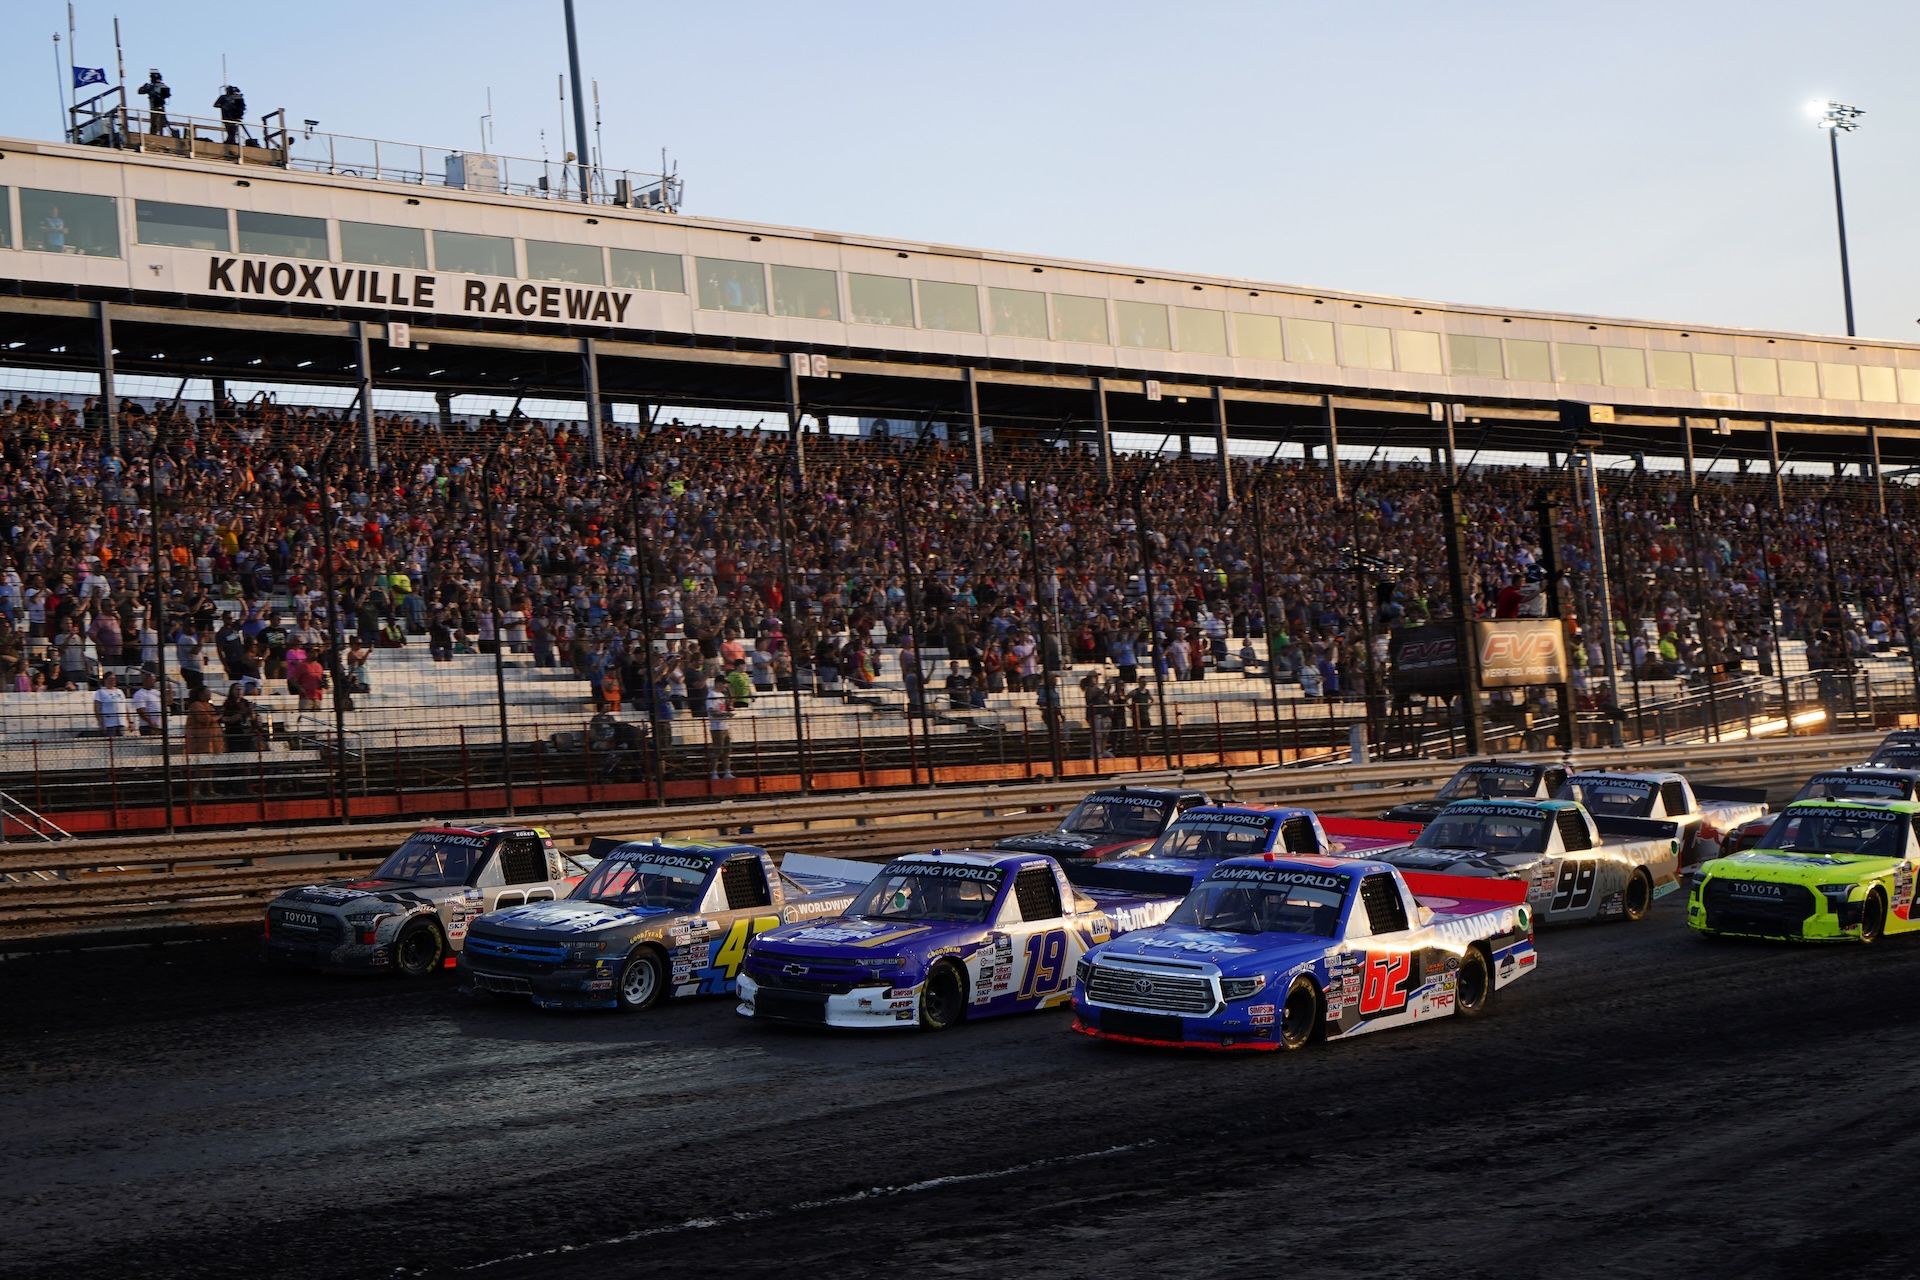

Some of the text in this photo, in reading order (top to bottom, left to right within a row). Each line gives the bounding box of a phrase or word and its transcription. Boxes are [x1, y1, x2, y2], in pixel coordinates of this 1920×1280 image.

[209, 256, 633, 322] KNOXVILLE RACEWAY
[395, 324, 405, 346] E
[798, 355, 807, 375] F
[814, 356, 827, 376] G
[1149, 382, 1158, 399] H
[1400, 639, 1457, 662] FVP
[1483, 633, 1556, 664] FVP
[1605, 780, 1648, 790] WORLD
[1811, 775, 1902, 788] CAMPING WORLD
[1085, 795, 1164, 808] CAMPING WORLD
[1180, 812, 1267, 826] CAMPING WORLD
[1440, 805, 1546, 819] CAMPING WORLD
[1787, 807, 1897, 822] CAMPING WORLD
[444, 835, 485, 848] WORLD
[549, 852, 558, 880] CURB
[607, 851, 704, 869] CAMPING WORLD
[885, 865, 998, 881] CAMPING WORLD
[1212, 868, 1339, 889] CAMPING WORLD
[1549, 858, 1598, 914] 99
[1734, 883, 1781, 896] TOYOTA
[285, 911, 318, 925] TOYOTA
[1091, 917, 1109, 935] NAPA
[1441, 912, 1499, 943] HALMAR
[629, 928, 664, 944] GOODYEAR
[927, 945, 962, 959] GOODYEAR
[673, 965, 690, 973] SKF
[1017, 928, 1069, 1000] 19
[1358, 948, 1412, 1014] 62
[1427, 976, 1438, 984] Mobil
[893, 989, 913, 997] SIMPSON
[1430, 993, 1455, 1008] TRD
[889, 1001, 913, 1009] ARP
[1249, 1006, 1274, 1014] SIMPSON
[1328, 1002, 1342, 1011] SKF
